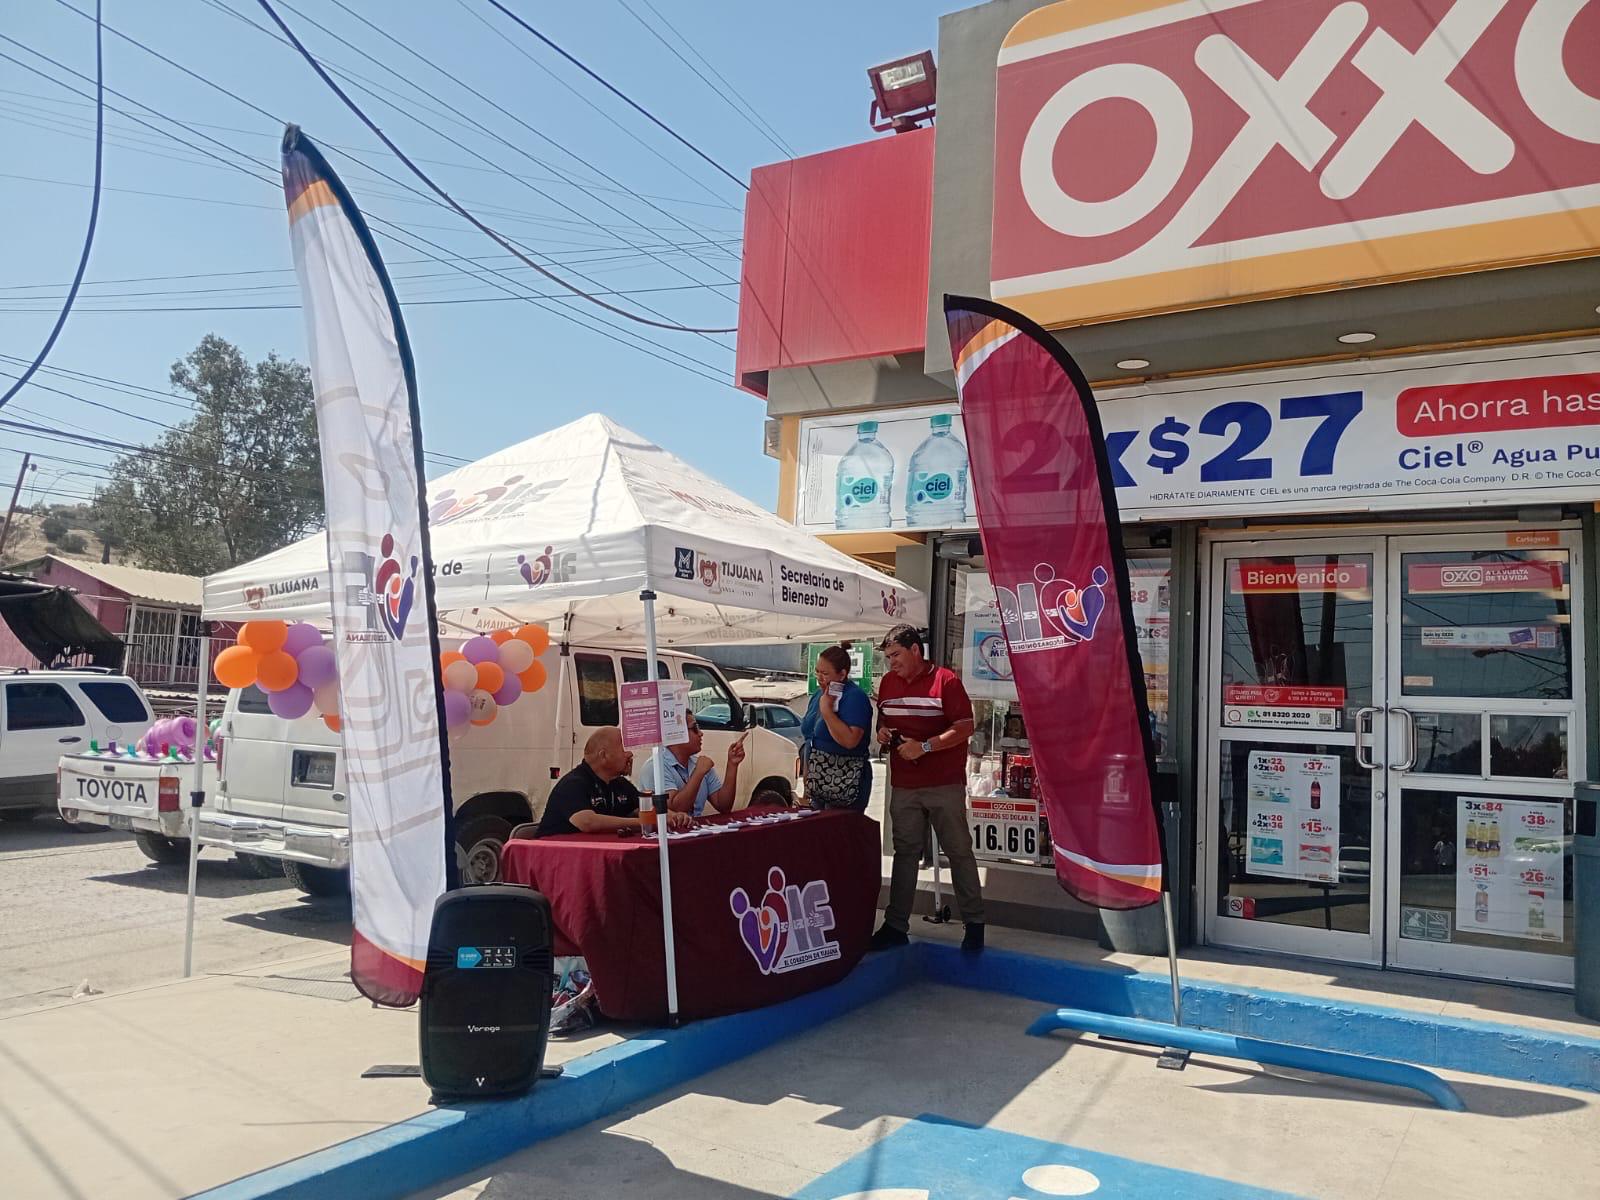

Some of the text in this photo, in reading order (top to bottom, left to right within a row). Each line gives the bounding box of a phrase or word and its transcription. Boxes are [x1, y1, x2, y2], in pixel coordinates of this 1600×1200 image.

[1413, 397, 1529, 424] Ahorra
[1492, 447, 1557, 468] Agua
[852, 481, 876, 496] ciel
[925, 477, 951, 492] ciel
[1197, 487, 1256, 500] DIARIAMENTE
[1260, 487, 1280, 496] CIEL
[1281, 487, 1292, 495] es
[1293, 486, 1310, 494] una
[1310, 484, 1337, 493] marca
[1338, 481, 1380, 492] registrada
[1381, 480, 1393, 488] de
[1396, 479, 1412, 487] The
[1414, 477, 1461, 487] Coca-Cola
[1462, 474, 1506, 484] Company
[1545, 471, 1564, 480] The
[441, 558, 463, 576] de
[721, 561, 765, 583] TIJUANA
[1247, 569, 1350, 585] Bienvenido
[1443, 569, 1481, 583] OXXO
[269, 577, 319, 596] TIJUANA
[780, 564, 845, 592] Secretaría de
[781, 585, 829, 608] Bienestar
[76, 777, 148, 804] TOYOTA
[993, 802, 1013, 810] OXXO
[973, 824, 1036, 855] 16.66
